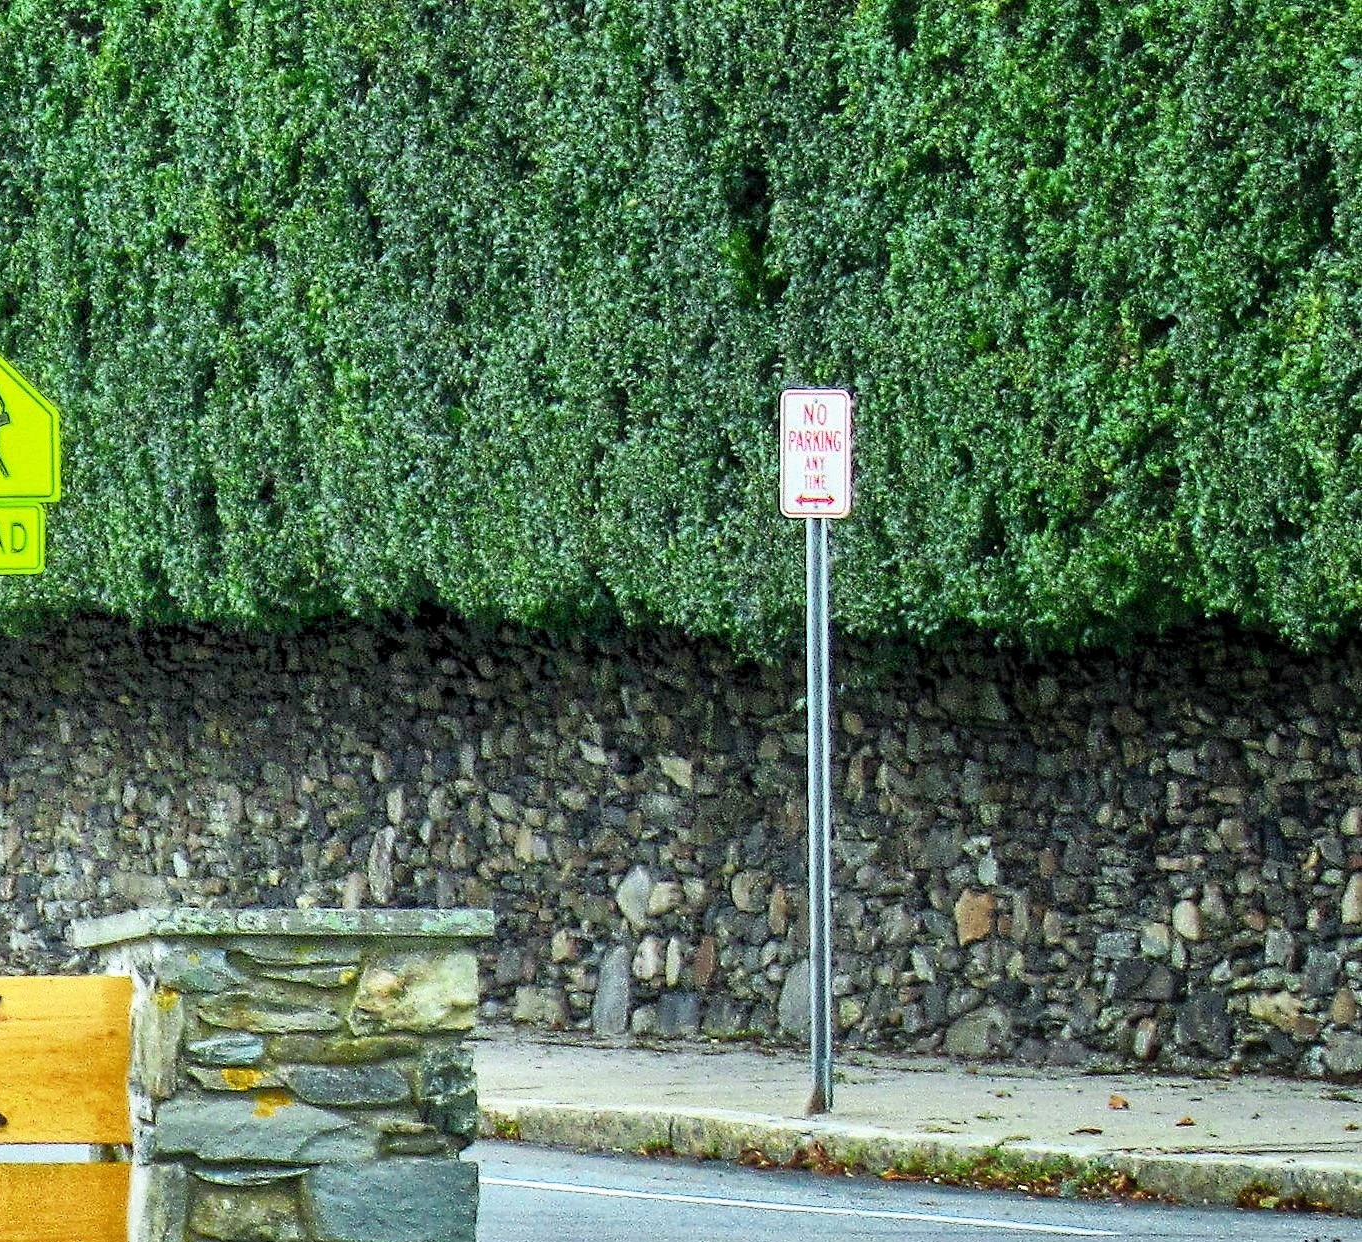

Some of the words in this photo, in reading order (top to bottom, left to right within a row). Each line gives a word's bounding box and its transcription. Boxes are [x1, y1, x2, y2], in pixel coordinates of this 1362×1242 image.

[804, 403, 827, 425] NO
[788, 430, 841, 452] PARKING
[805, 456, 825, 471] ANY
[804, 474, 826, 490] TIME
